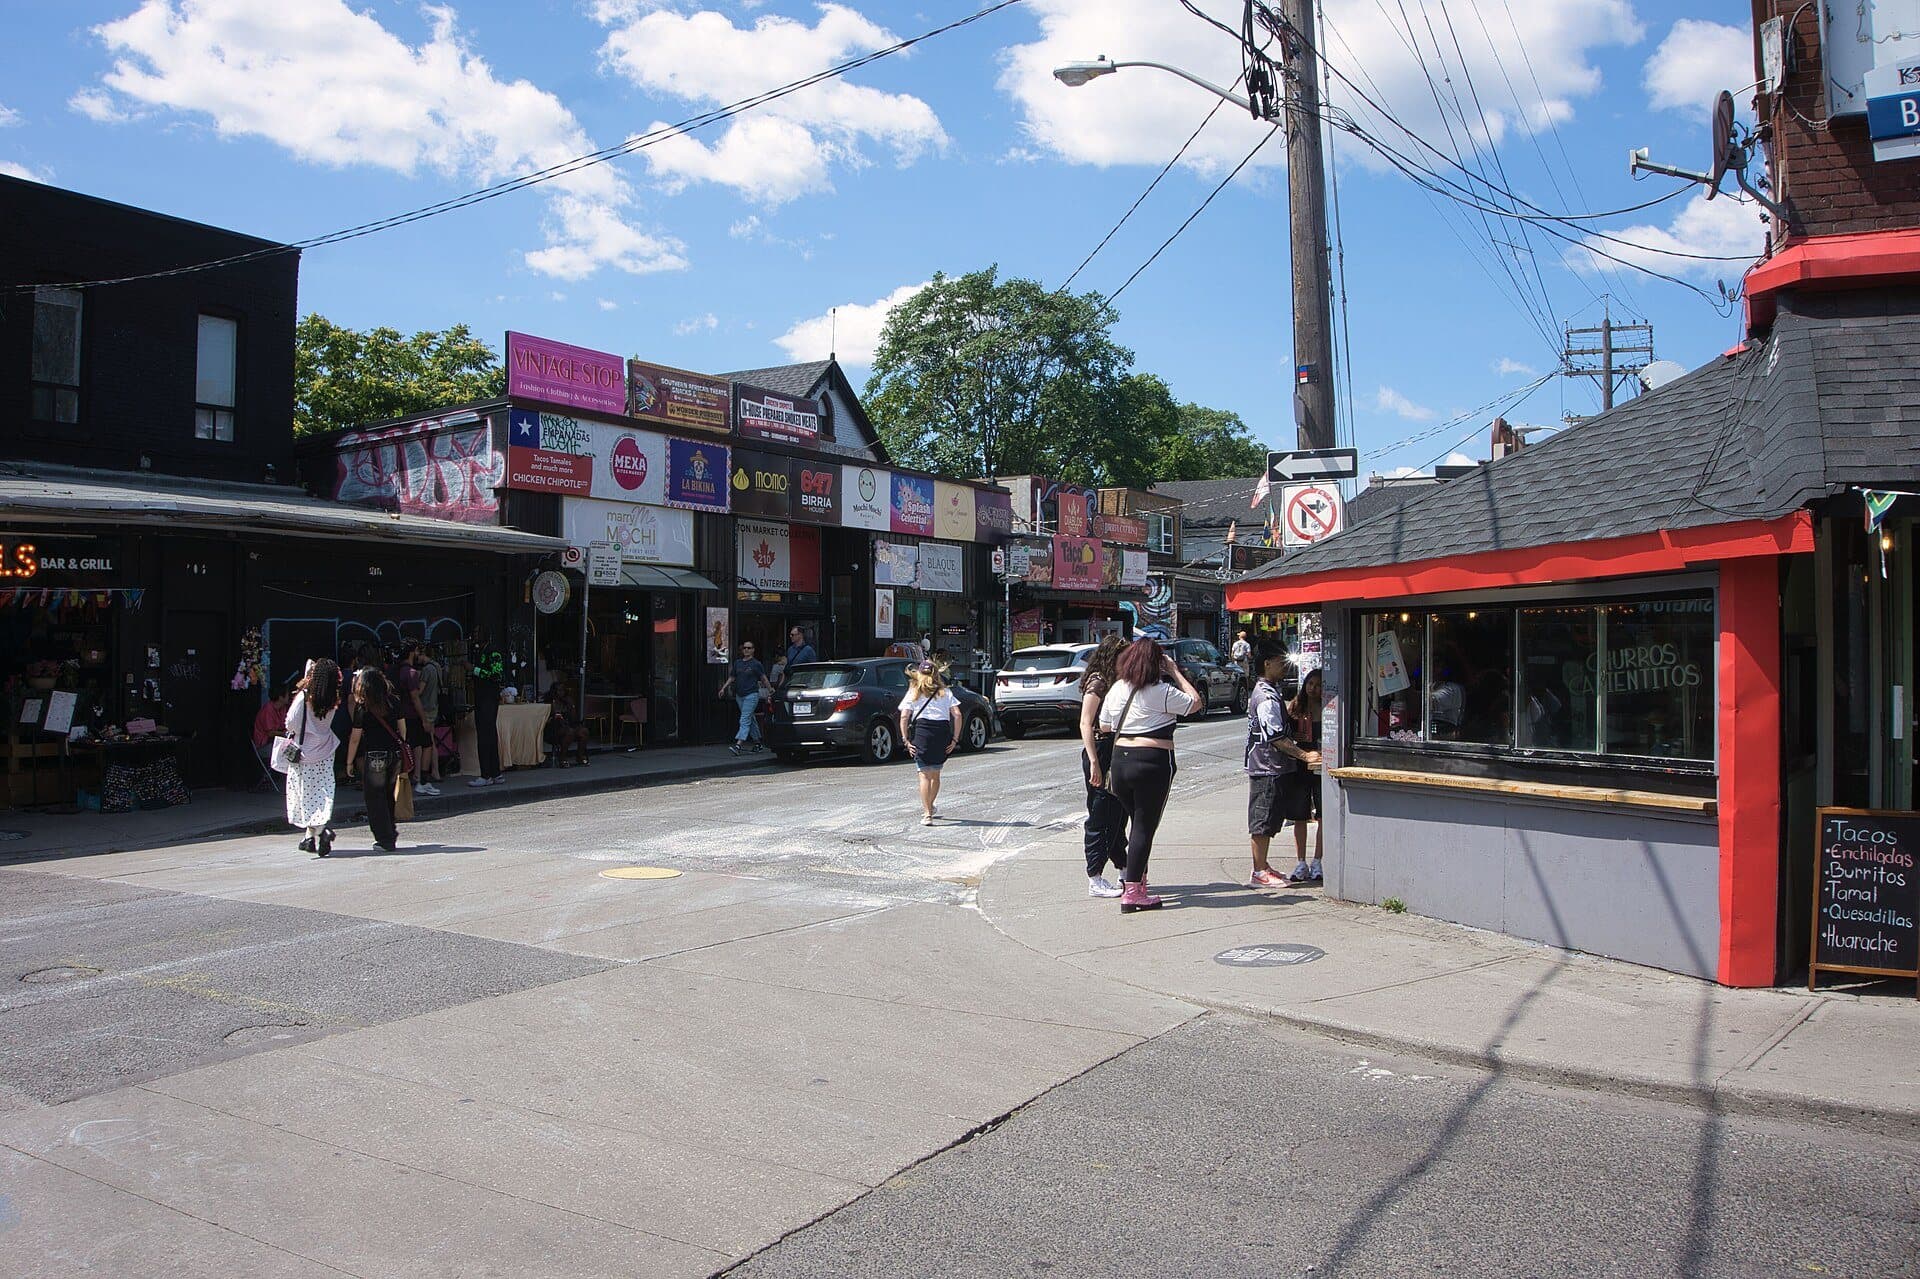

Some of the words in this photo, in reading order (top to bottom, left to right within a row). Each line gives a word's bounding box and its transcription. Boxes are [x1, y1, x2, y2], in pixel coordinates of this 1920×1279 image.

[513, 347, 579, 381] VINTAGE
[581, 363, 621, 389] STOP
[520, 381, 545, 394] Fashion
[660, 377, 688, 388] SOUTHERN
[688, 383, 709, 393] AFRICAN
[543, 427, 590, 443] EMPANADAS
[531, 462, 541, 470] and
[543, 464, 558, 472] much
[559, 466, 573, 474] more
[533, 454, 550, 463] Tacos
[550, 456, 572, 466] Tamales
[614, 454, 646, 472] MEXA
[513, 472, 546, 485] CHICKEN
[547, 477, 581, 489] CHIPOTLE
[681, 478, 690, 490] LA
[800, 469, 833, 496] 647
[801, 494, 833, 509] BIRRIA
[907, 501, 931, 515] Splash
[631, 505, 657, 525] Me
[808, 506, 825, 514] HOUSE
[606, 511, 635, 526] marry
[606, 525, 656, 545] MOCHI
[753, 525, 778, 537] MARKET
[41, 557, 65, 569] BAR
[68, 558, 78, 570] &
[80, 558, 113, 570] GRILL
[758, 554, 771, 565] 210
[927, 557, 956, 572] BLAQUE
[1568, 663, 1700, 696] CAIENTITOS
[1830, 819, 1898, 845] Tacos
[1831, 843, 1914, 868] Enchiladas
[1830, 861, 1906, 887] Burritos
[1826, 880, 1878, 903] Tamal
[1828, 903, 1914, 929] Quesadillas
[1826, 923, 1898, 953] Huarache
